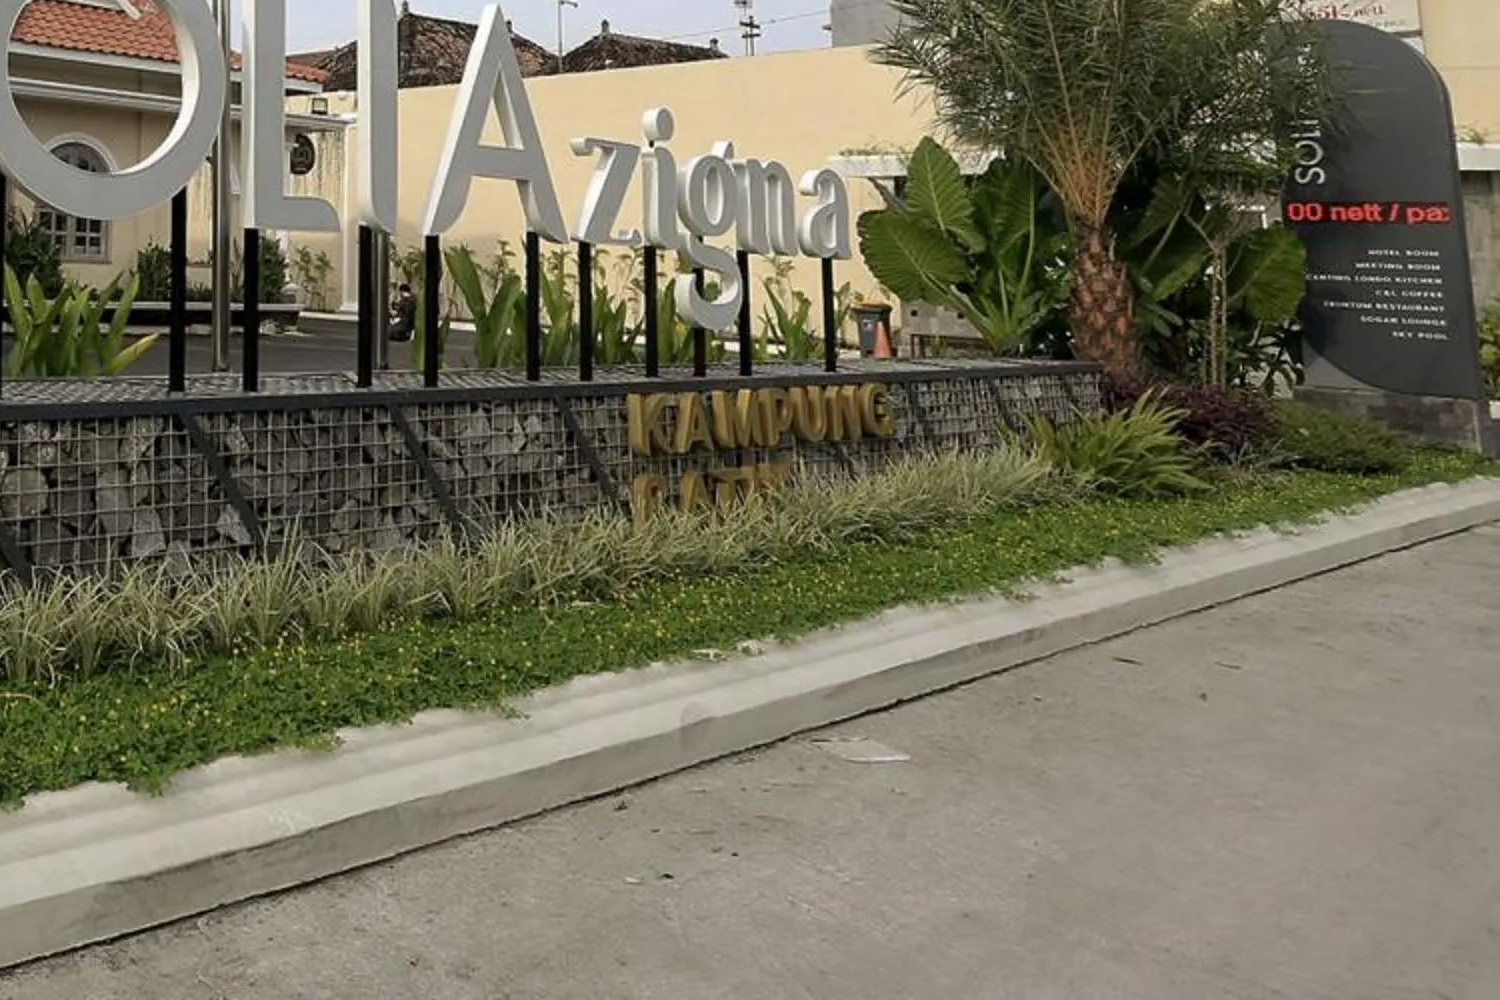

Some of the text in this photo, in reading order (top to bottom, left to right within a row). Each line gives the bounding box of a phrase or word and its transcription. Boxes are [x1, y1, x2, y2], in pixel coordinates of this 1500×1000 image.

[1328, 202, 1383, 222] nett
[569, 106, 852, 330] zigna
[1355, 262, 1442, 271] MEETING ROOM
[1305, 273, 1443, 285] CANTING LONDO KITCHEN
[1401, 290, 1444, 299] COFFEE
[1375, 302, 1445, 312] RESTAURANT
[1417, 331, 1449, 340] POOL
[626, 381, 896, 455] KAMPUNG
